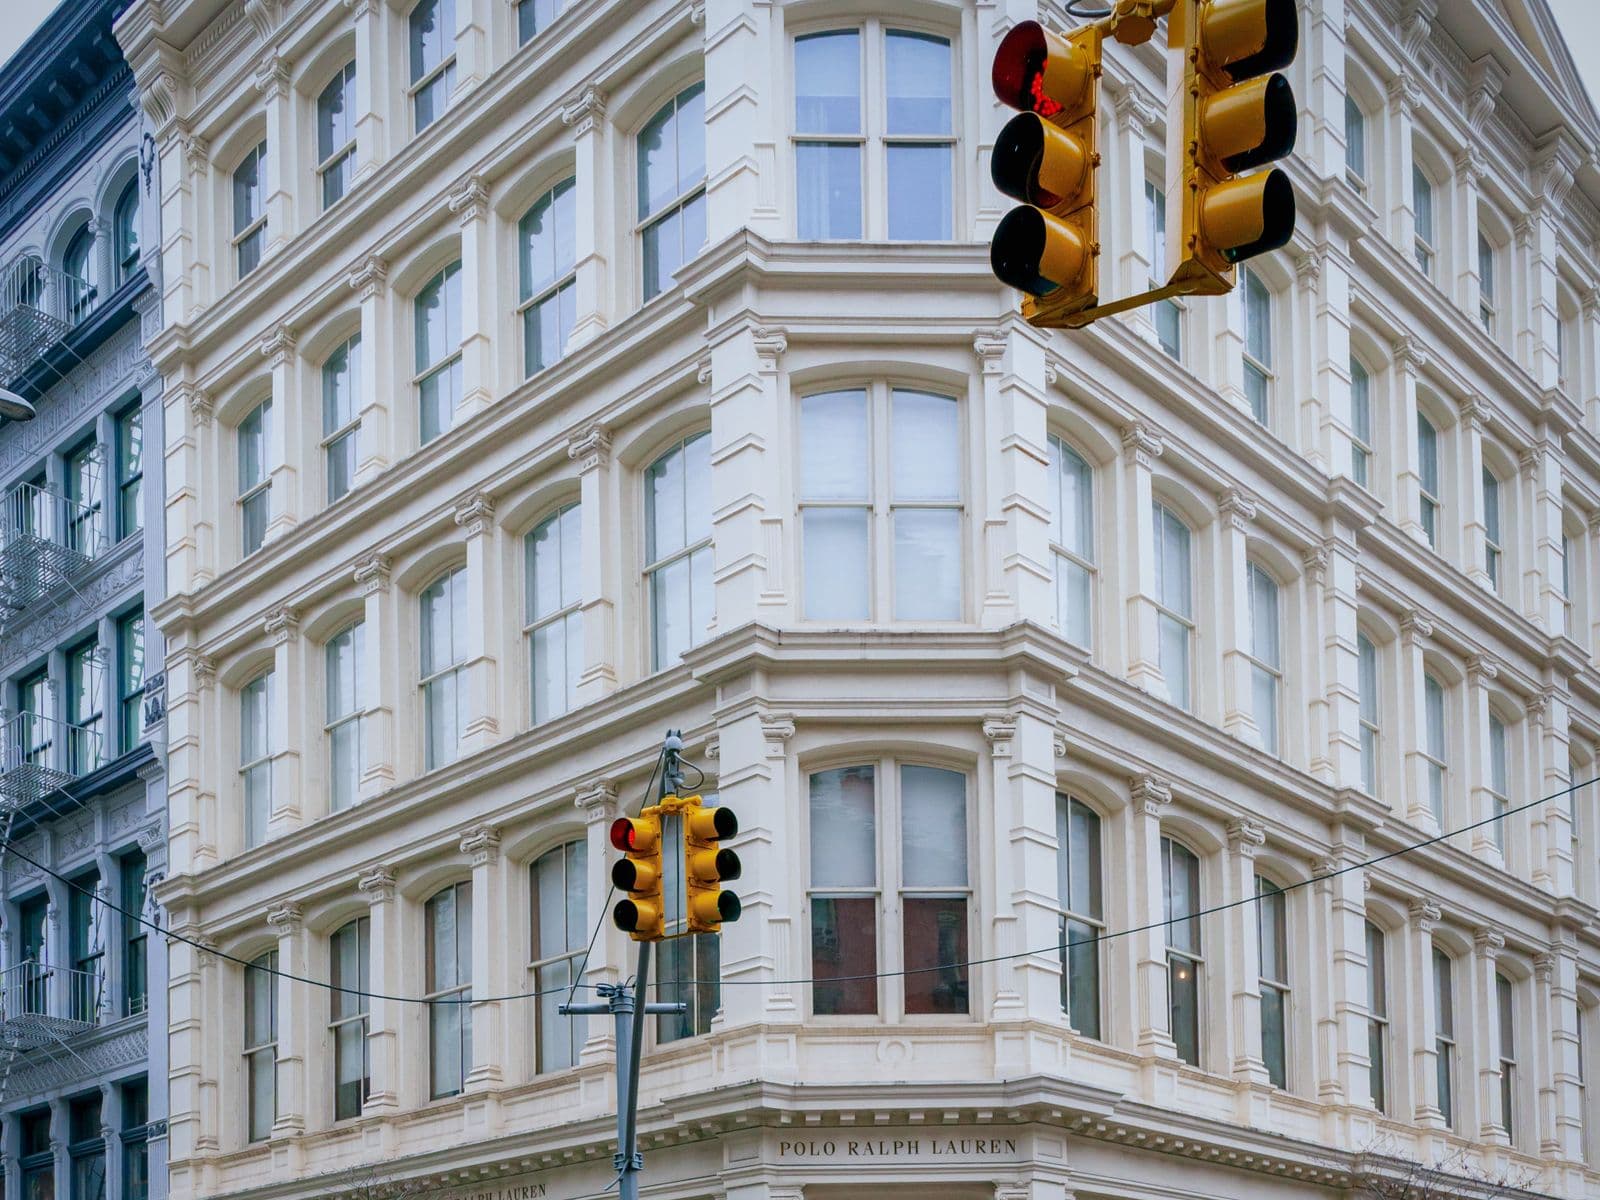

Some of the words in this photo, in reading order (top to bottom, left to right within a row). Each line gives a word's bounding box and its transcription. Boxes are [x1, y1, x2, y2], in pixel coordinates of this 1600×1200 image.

[780, 1141, 836, 1156] POLO
[848, 1140, 919, 1156] RALPH
[932, 1139, 1016, 1155] LAUREN
